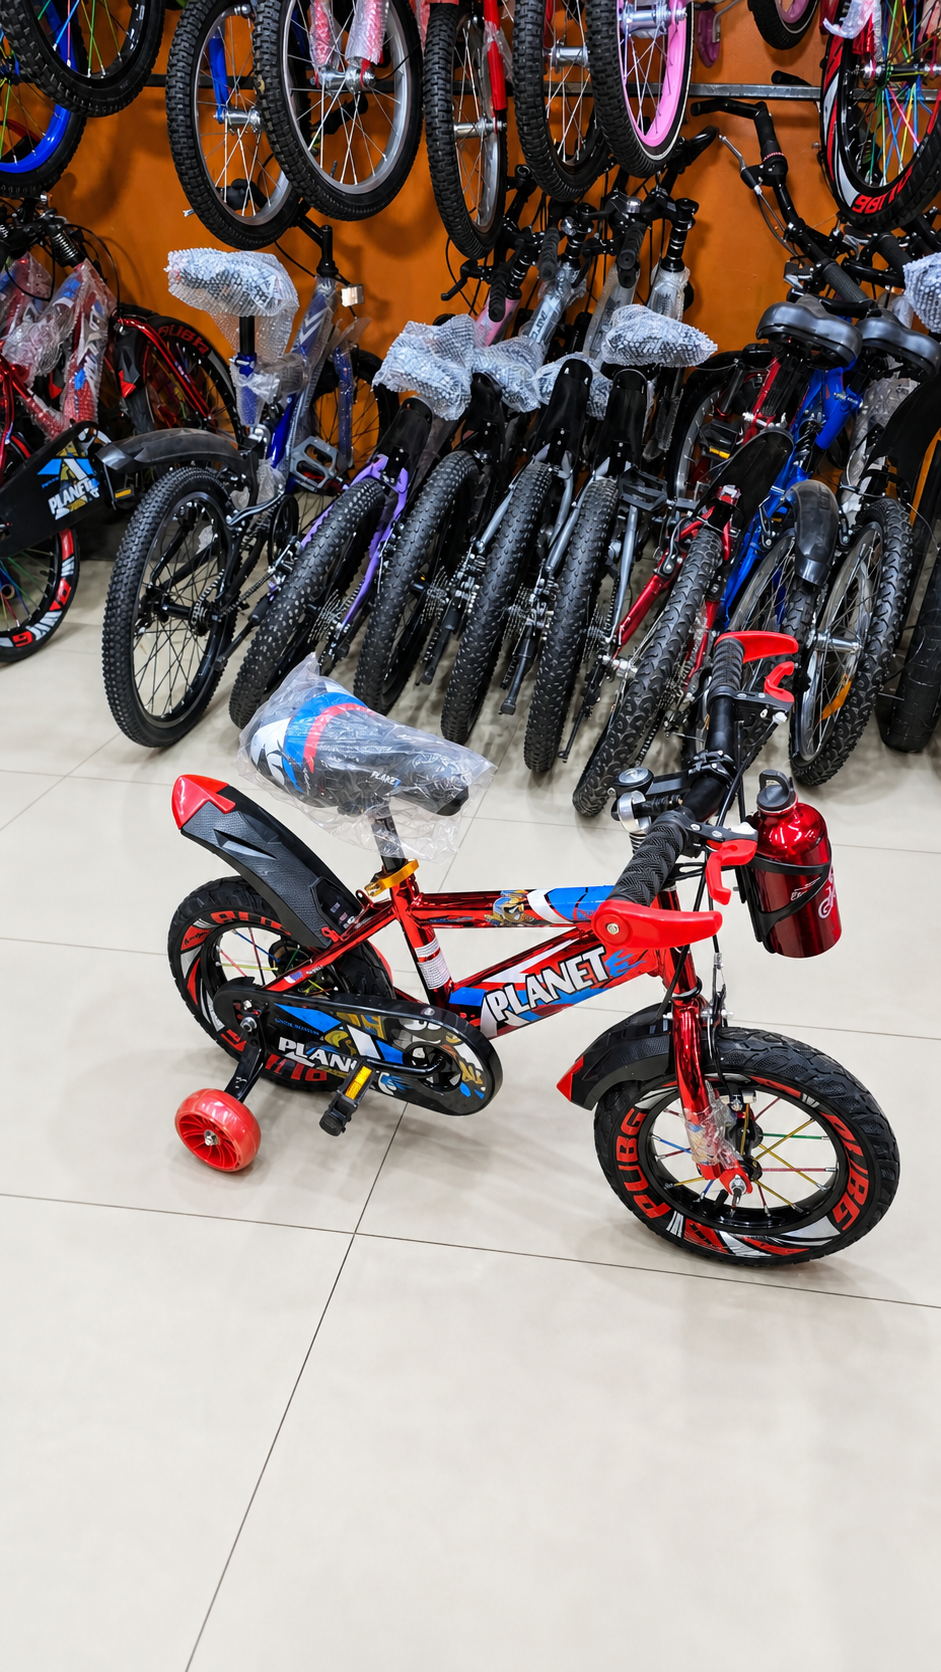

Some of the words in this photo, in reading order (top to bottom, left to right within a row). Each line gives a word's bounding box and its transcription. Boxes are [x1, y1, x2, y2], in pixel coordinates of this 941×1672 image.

[48, 478, 93, 515] PLANET
[370, 770, 402, 789] PLANET
[487, 946, 609, 1022] PLANET
[616, 1107, 672, 1219] PUBG
[818, 1111, 870, 1231] PUBG
